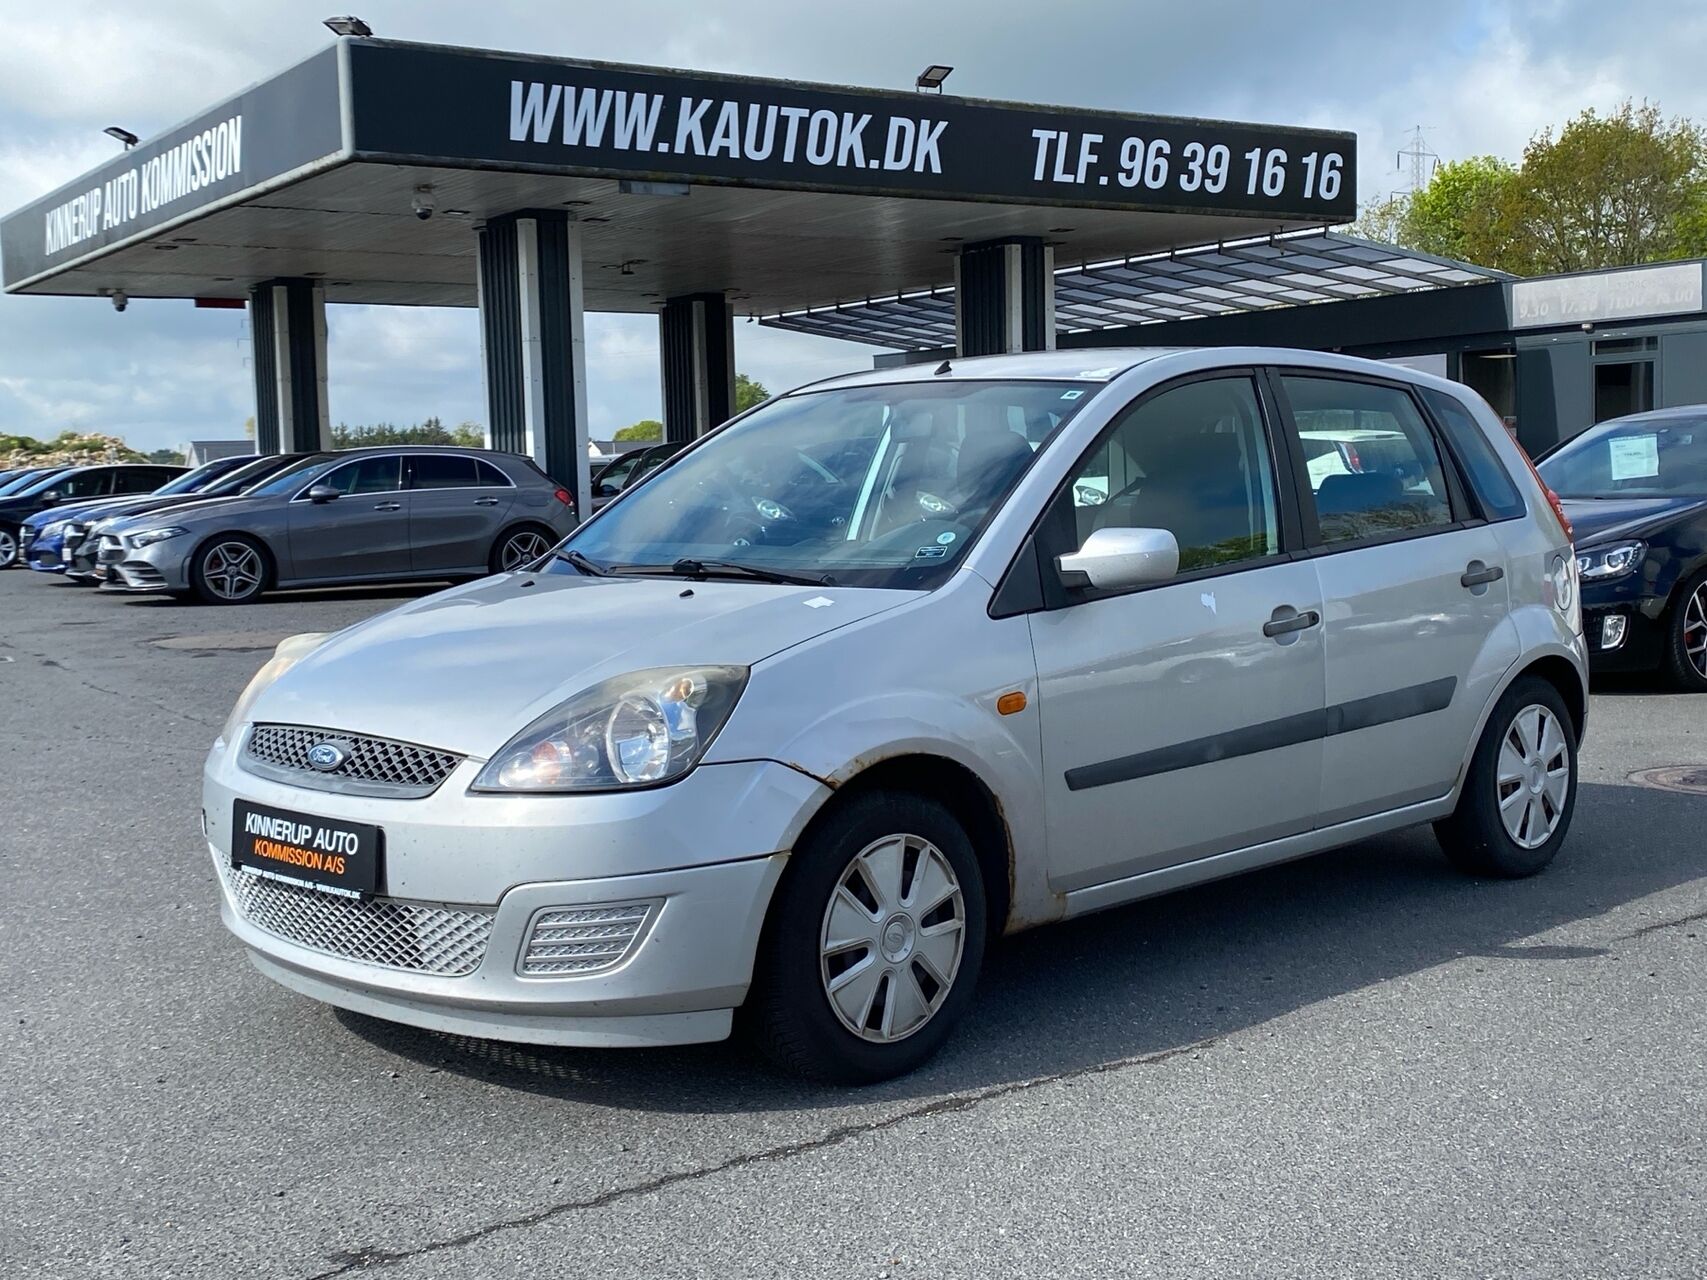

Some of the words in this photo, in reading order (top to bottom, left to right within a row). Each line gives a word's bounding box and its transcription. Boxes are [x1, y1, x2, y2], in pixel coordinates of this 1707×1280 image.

[510, 80, 948, 174] WWW.KAUTOK.DK
[45, 188, 102, 256] KINNERUP
[102, 168, 138, 231] AUTO
[141, 115, 242, 215] KOMMISSION
[1032, 129, 1108, 186] TLF.
[1118, 137, 1171, 190] 96
[1179, 142, 1231, 194] 39
[1245, 147, 1287, 197] 16
[1302, 151, 1344, 200] 16
[245, 812, 312, 845] KINNERUP
[313, 828, 359, 855] AUTO
[254, 839, 323, 870] KOMMISSION
[324, 855, 345, 875] A/S
